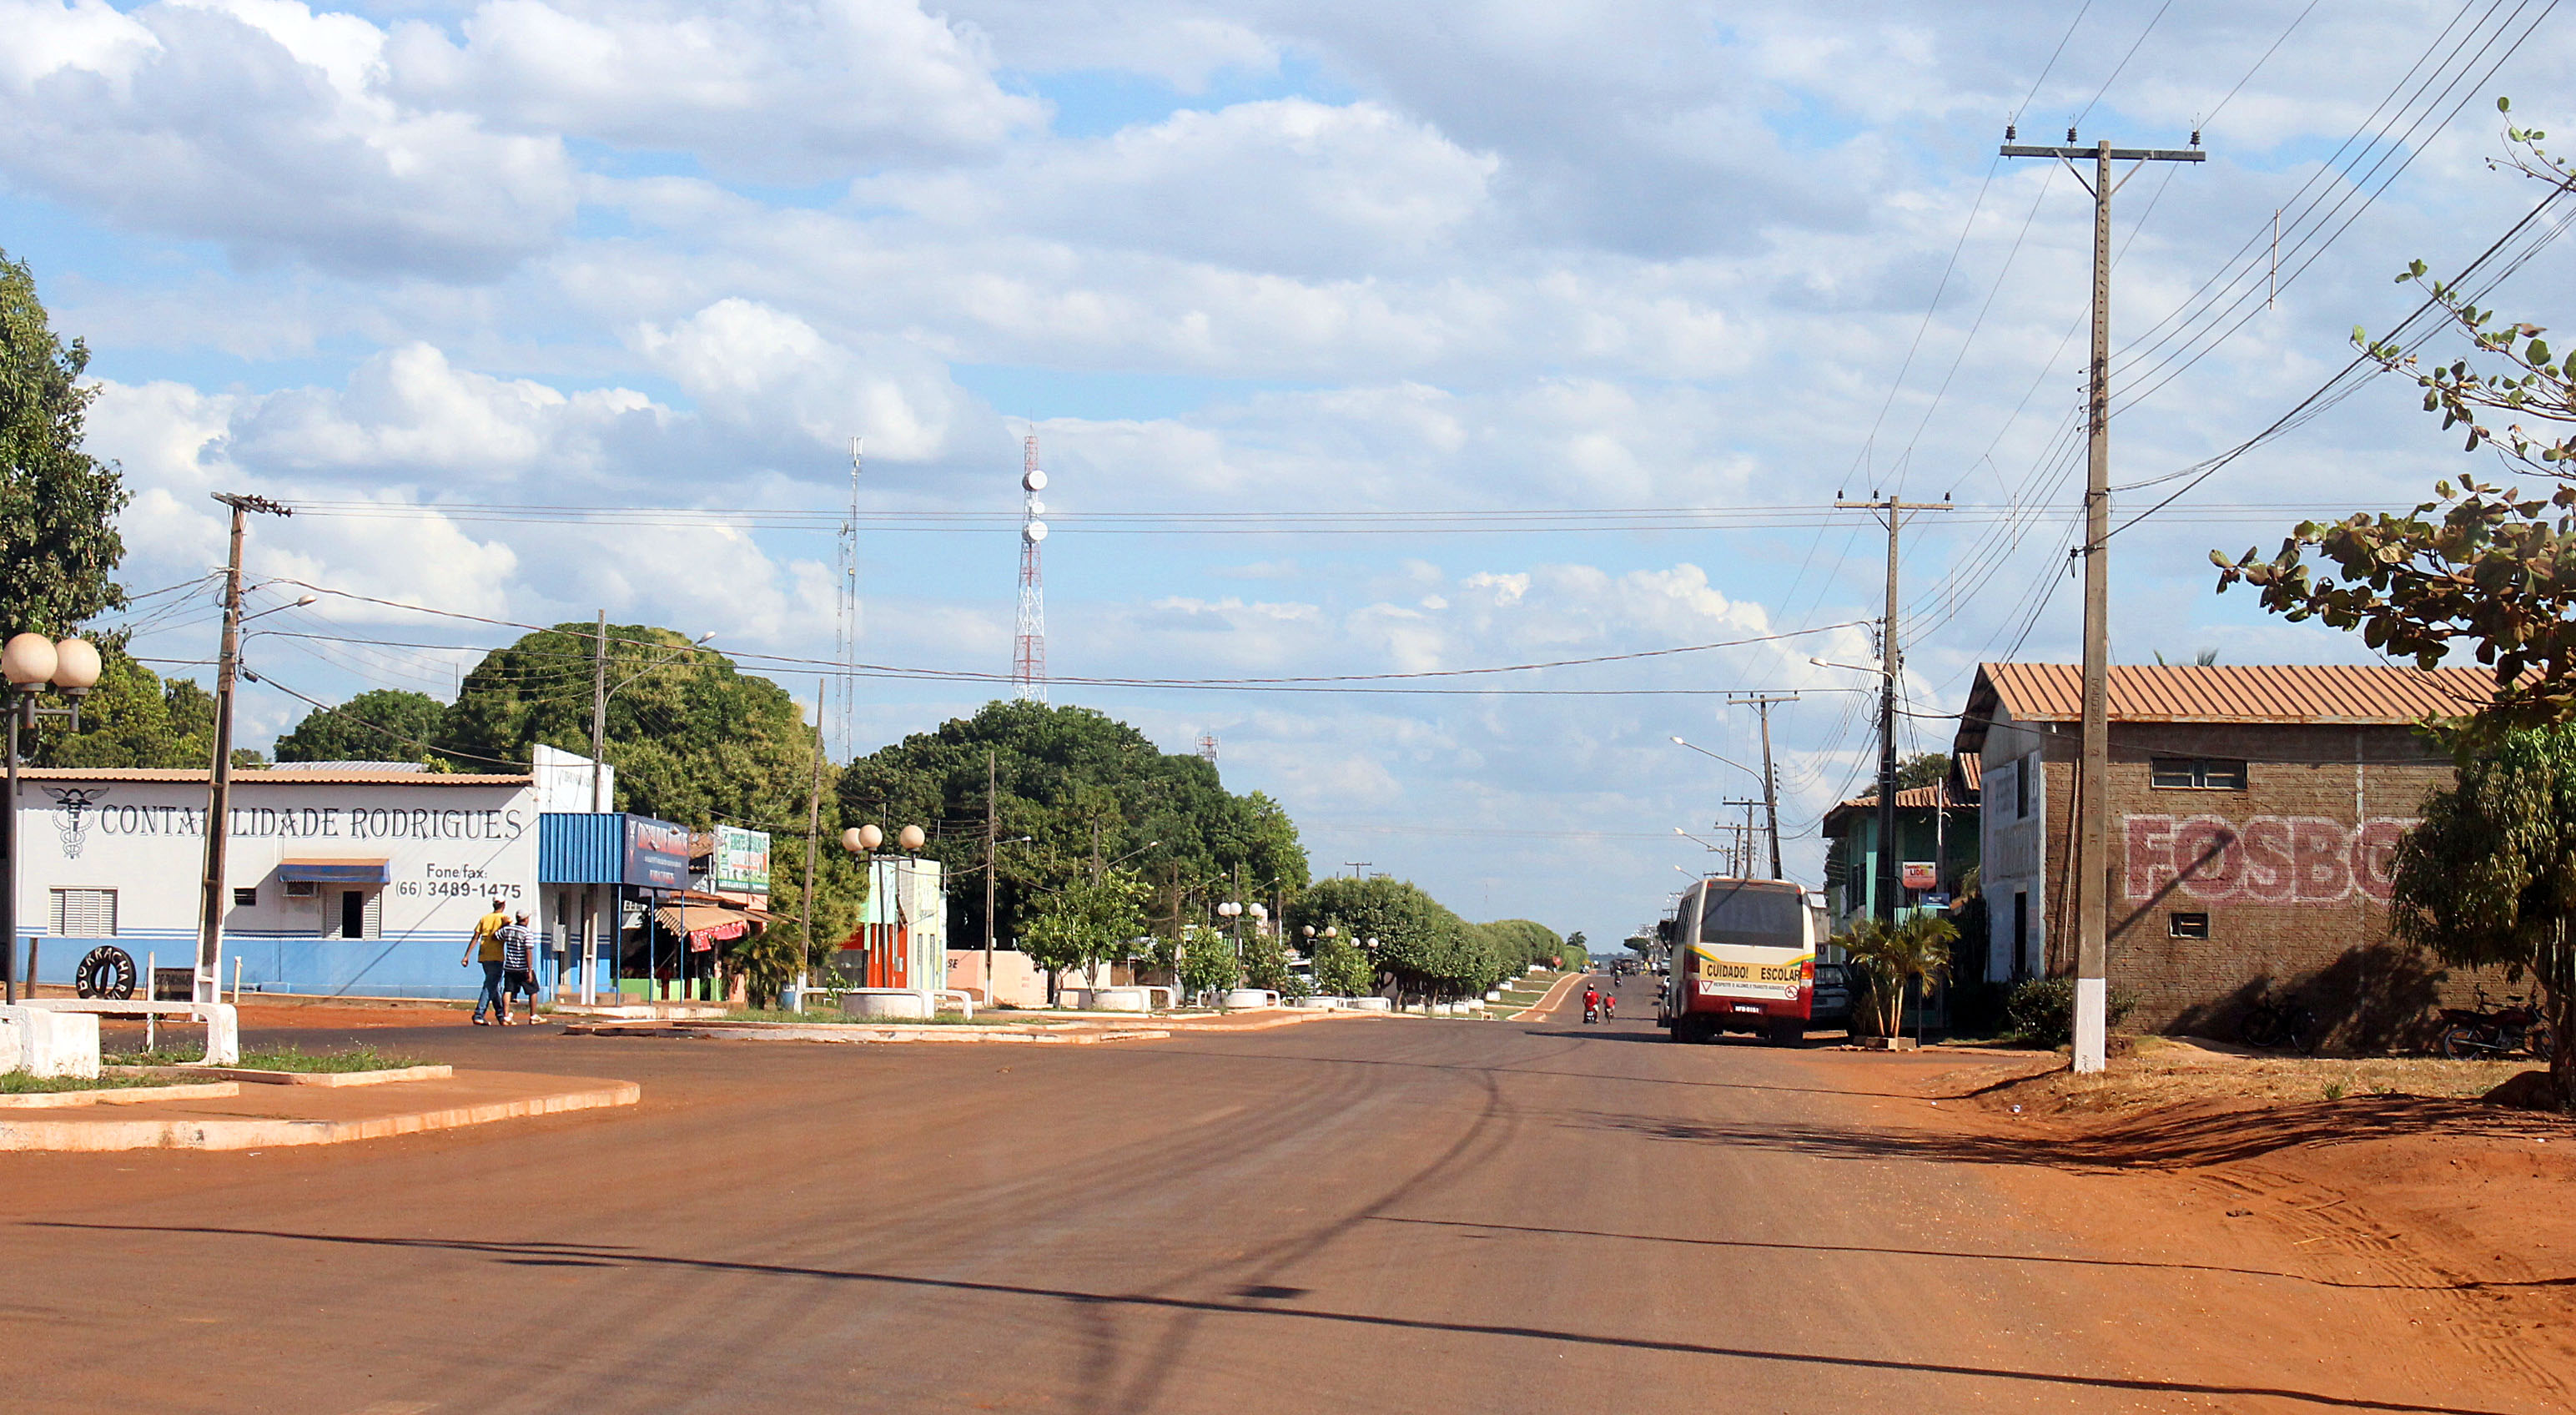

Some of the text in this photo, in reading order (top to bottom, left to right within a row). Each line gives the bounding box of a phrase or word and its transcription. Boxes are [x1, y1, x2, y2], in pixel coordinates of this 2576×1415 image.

[100, 803, 522, 842] CONTALIDADE RODRIGUES
[395, 881, 522, 899] (66) 3489-1475
[1707, 964, 1801, 982] CUIDADO! ESCOLAR
